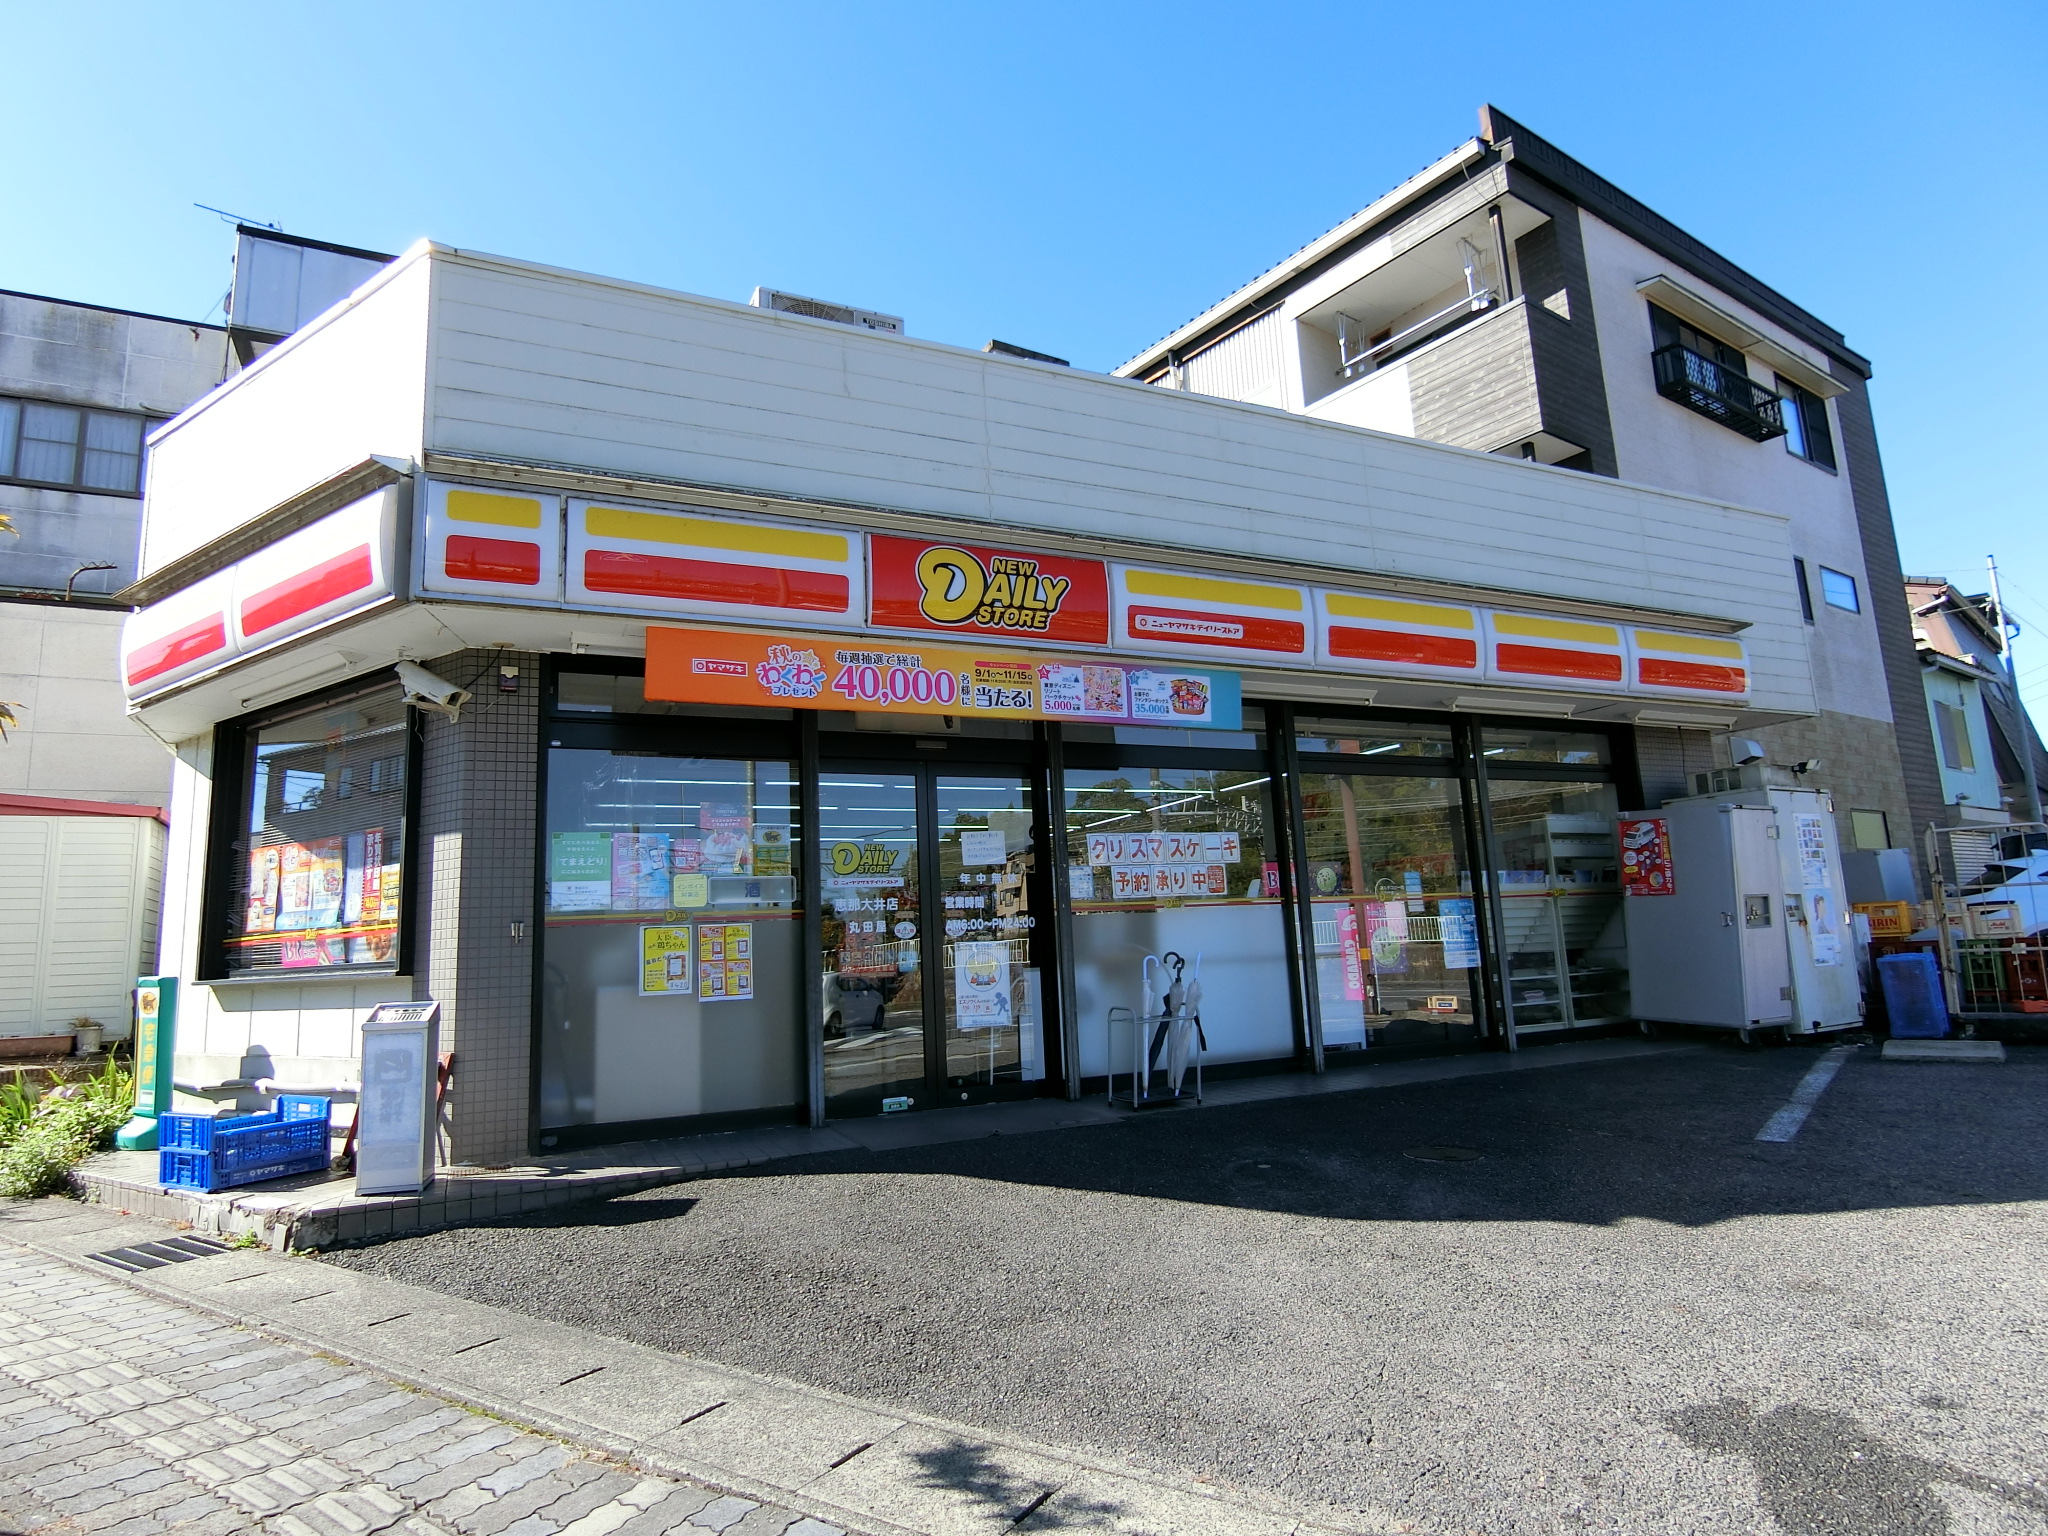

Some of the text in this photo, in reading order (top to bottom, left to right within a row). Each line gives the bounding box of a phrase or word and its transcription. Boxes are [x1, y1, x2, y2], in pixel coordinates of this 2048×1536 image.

[866, 319, 893, 329] TOSHIBA
[994, 559, 1037, 575] NEW
[917, 547, 1069, 623] DAILY
[978, 606, 1049, 629] STORE
[770, 646, 801, 664] 秋の
[836, 651, 921, 668] 毎週抽選で総計
[760, 664, 826, 690] わくわく
[834, 665, 955, 704] 40,000
[773, 685, 816, 697] プレゼント
[961, 673, 971, 706] 名様に
[1045, 700, 1072, 710] 5,000
[1135, 704, 1165, 714] 35,000
[1092, 837, 1237, 860] クリスマスケーキ
[832, 842, 899, 876] DAILY
[857, 865, 890, 874] STORE
[960, 873, 1018, 885] 年中無休
[1116, 869, 1207, 892] 予約承り中
[745, 883, 760, 898] 酒
[835, 897, 899, 912] 恵那大井店
[945, 896, 985, 909] 営業時間
[849, 920, 887, 934] 丸田屋
